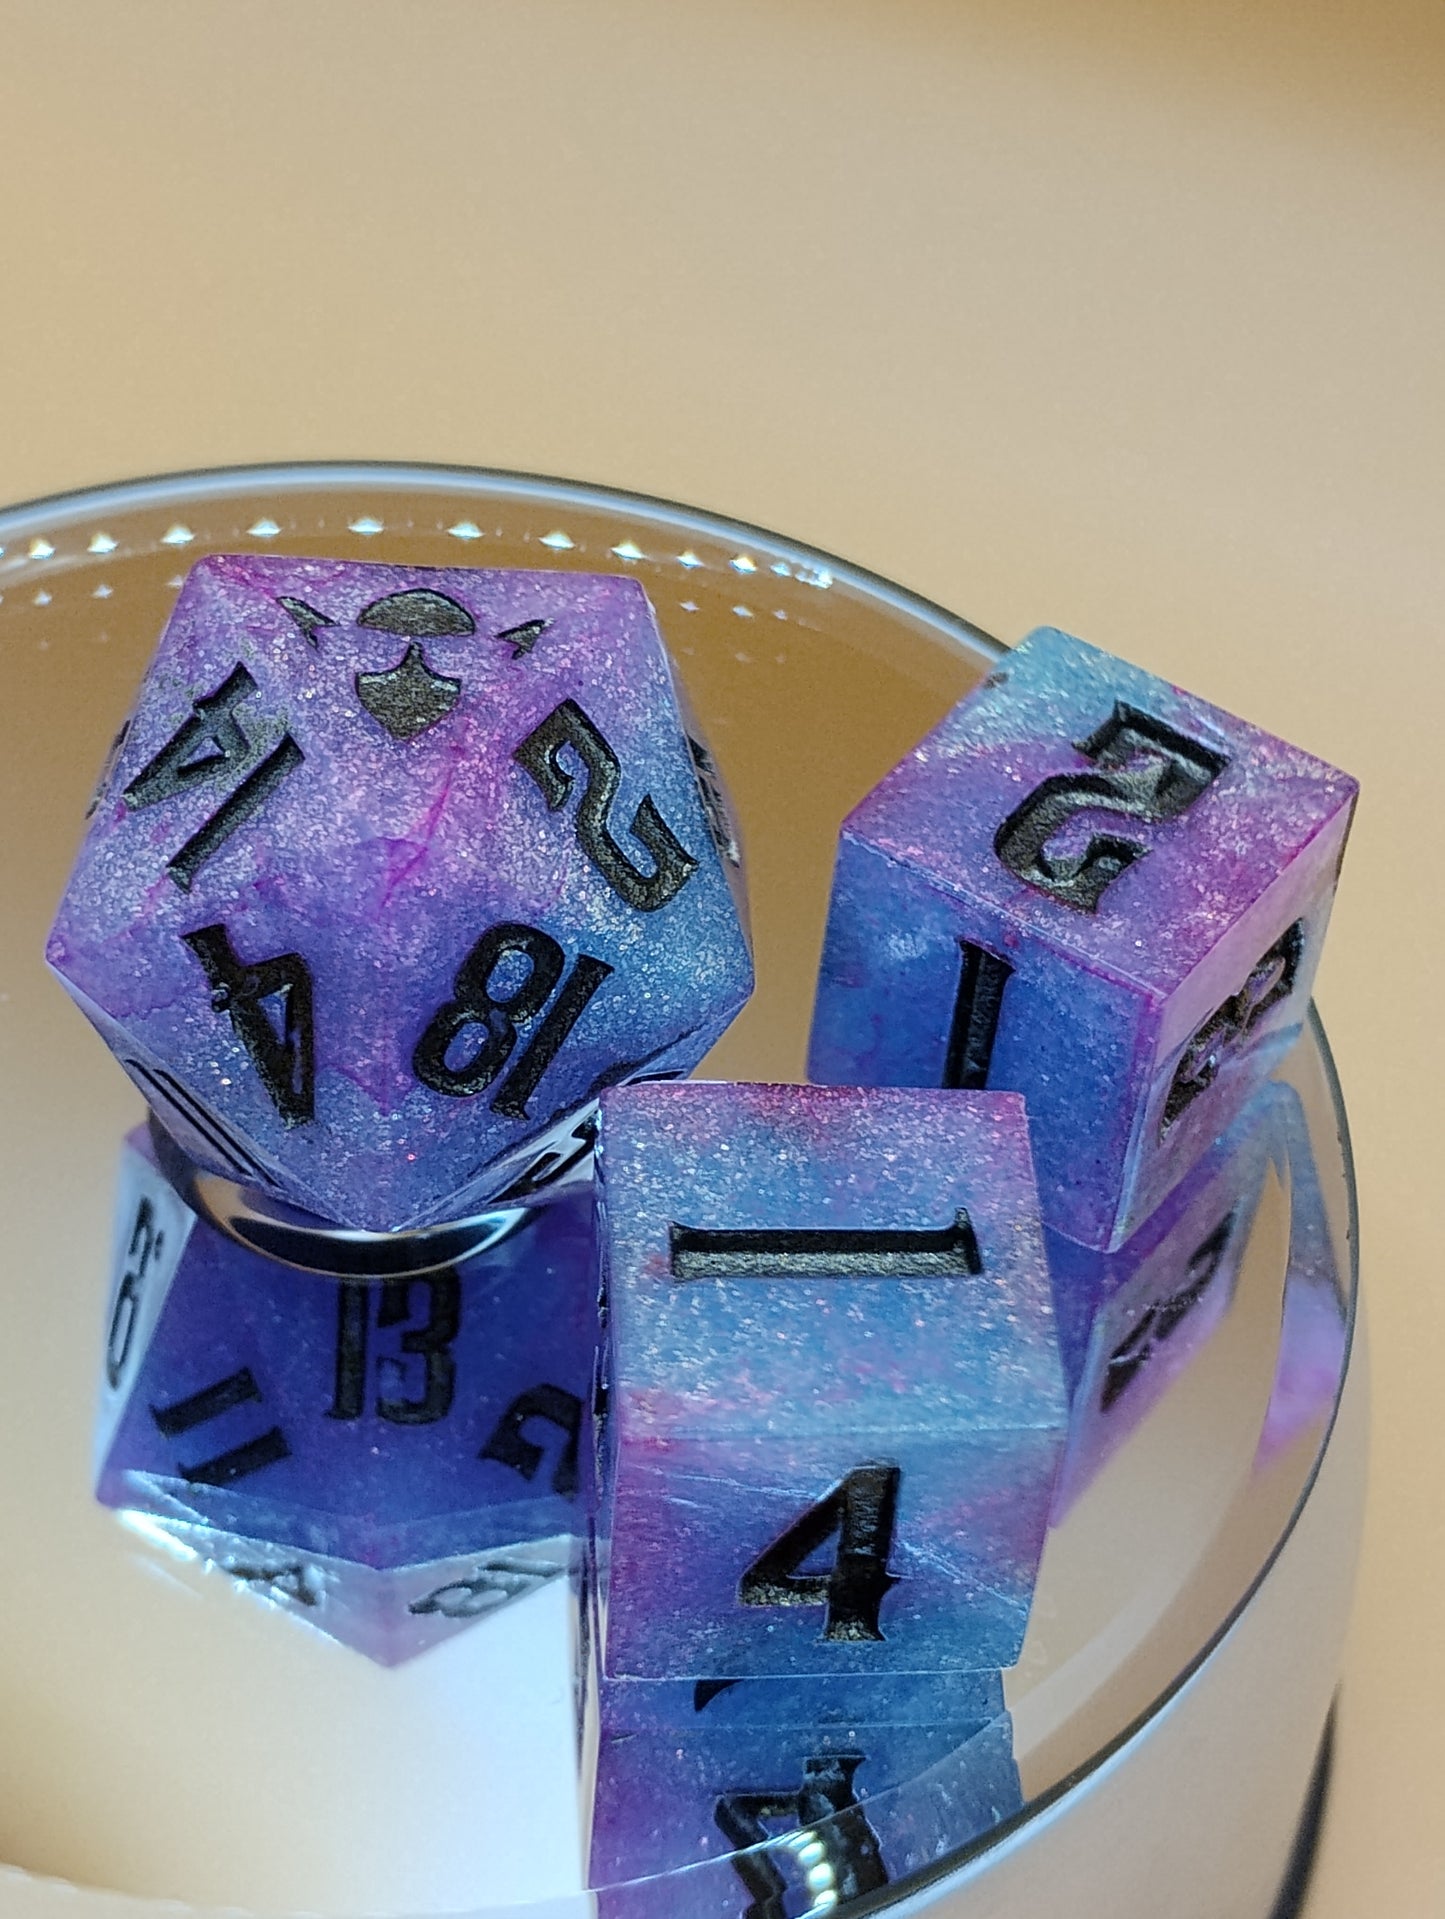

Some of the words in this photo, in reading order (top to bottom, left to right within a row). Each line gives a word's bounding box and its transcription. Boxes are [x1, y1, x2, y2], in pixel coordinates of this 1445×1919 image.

[181, 922, 316, 1126] 4
[413, 921, 615, 1120] 18
[669, 1207, 984, 1282] 1
[738, 1460, 900, 1642] 4
